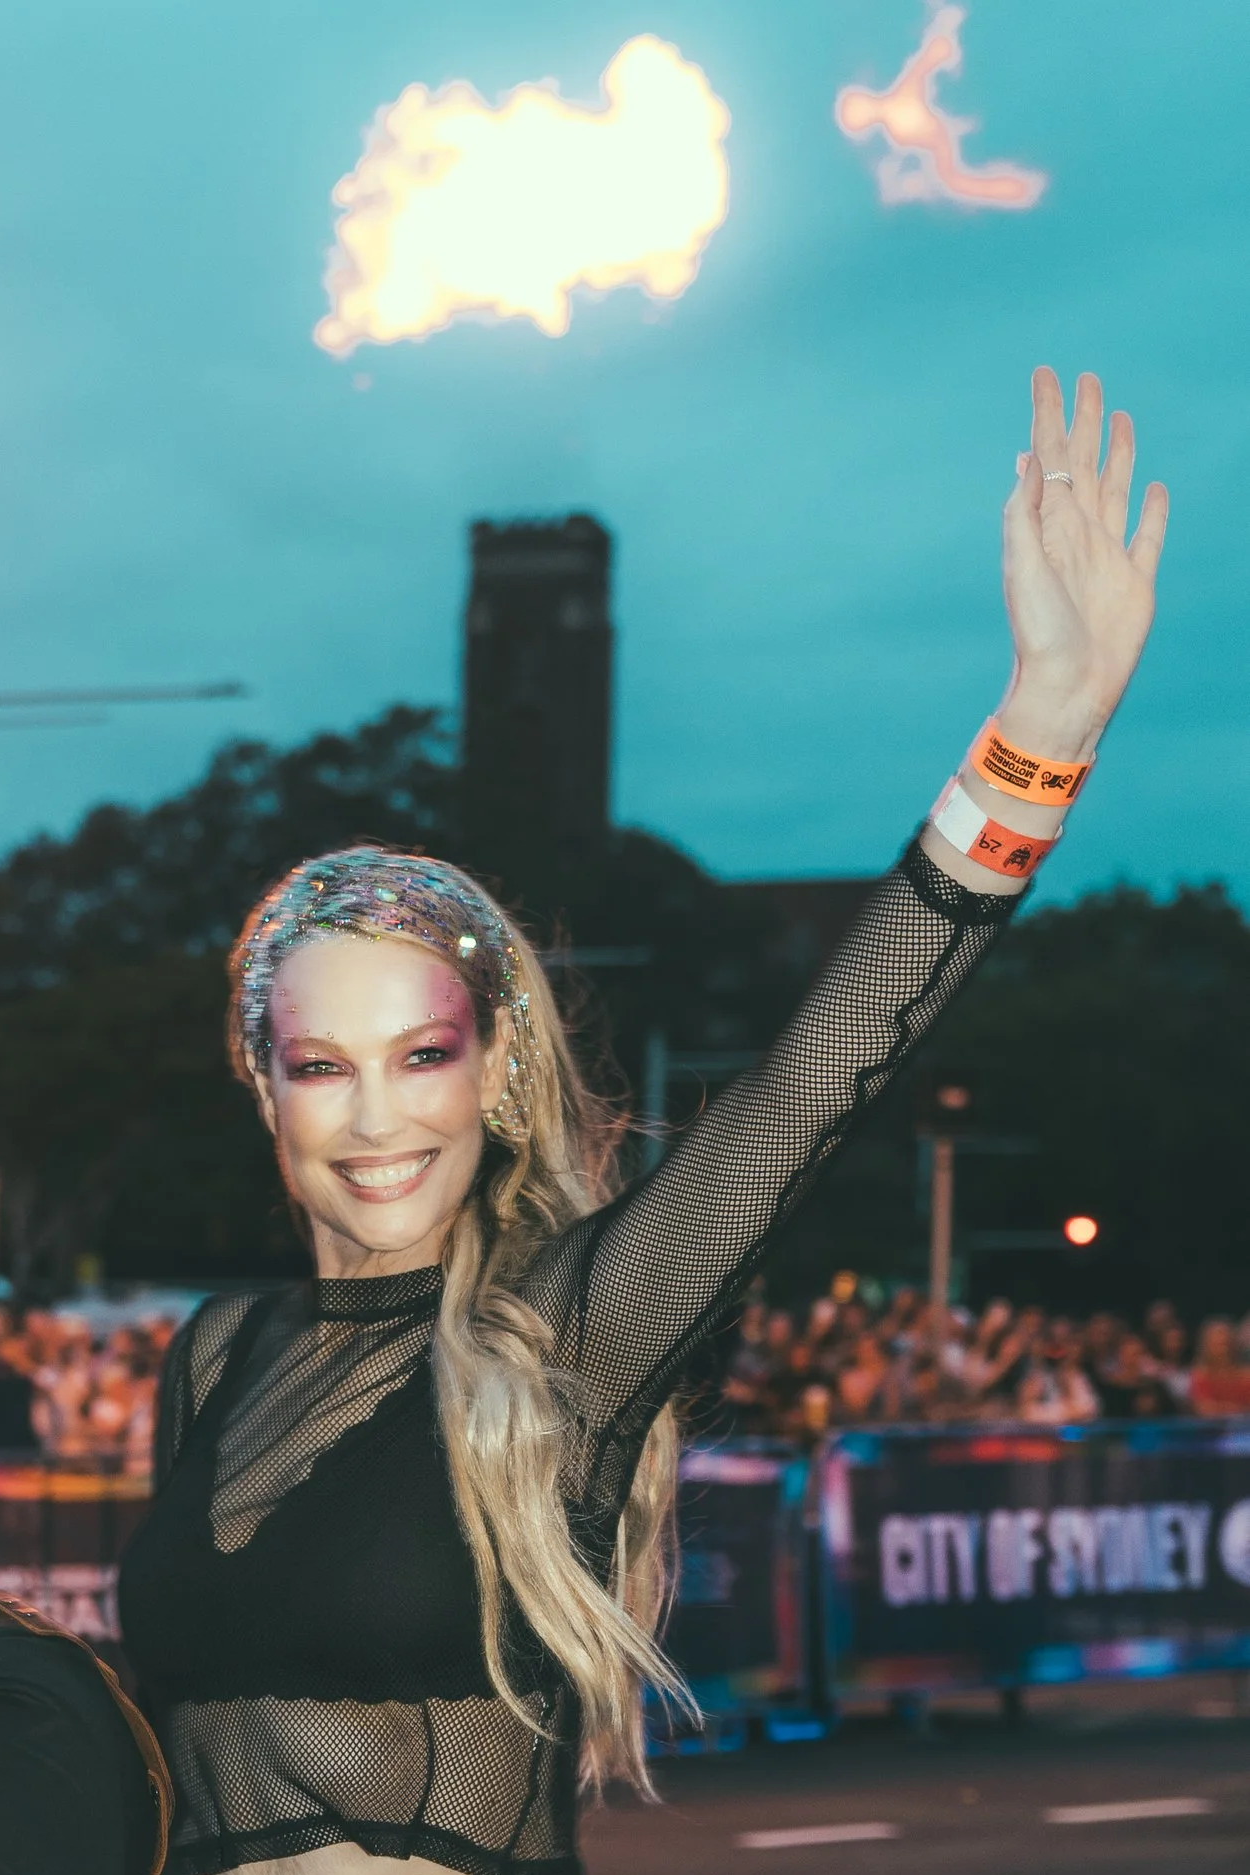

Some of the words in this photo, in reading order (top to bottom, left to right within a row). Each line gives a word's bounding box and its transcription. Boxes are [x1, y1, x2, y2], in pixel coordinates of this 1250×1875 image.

[987, 745, 1037, 780] MOTORBIKE
[881, 1512, 982, 1608] CITY
[986, 1507, 1044, 1604] OF
[1046, 1501, 1213, 1598] SYDNEY
